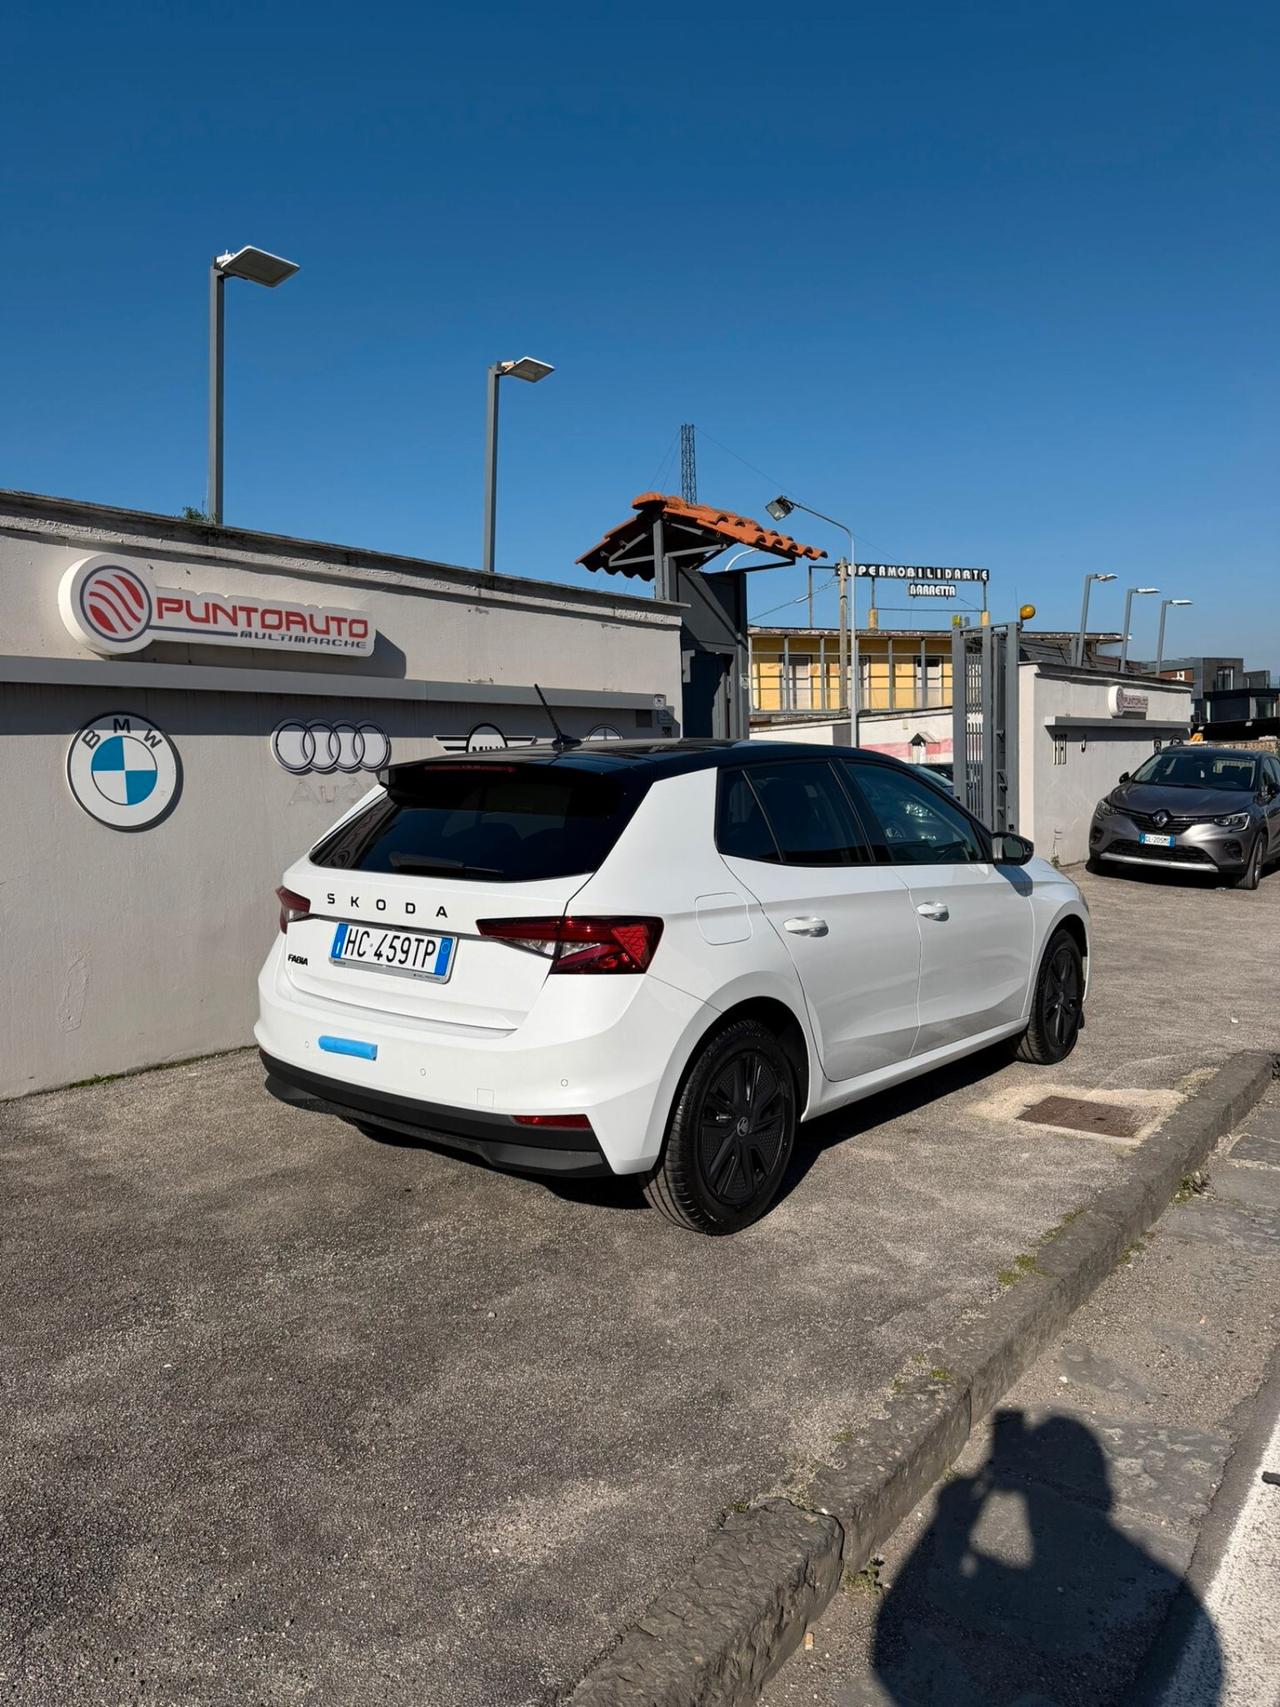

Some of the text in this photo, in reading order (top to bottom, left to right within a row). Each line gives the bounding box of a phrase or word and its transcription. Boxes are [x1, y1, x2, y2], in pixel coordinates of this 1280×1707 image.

[910, 584, 956, 596] BARRETTA
[156, 597, 368, 639] PUNTOAUTO
[239, 630, 366, 649] MULTIMARCHE
[82, 718, 162, 750] BMW
[327, 893, 448, 918] SKODA
